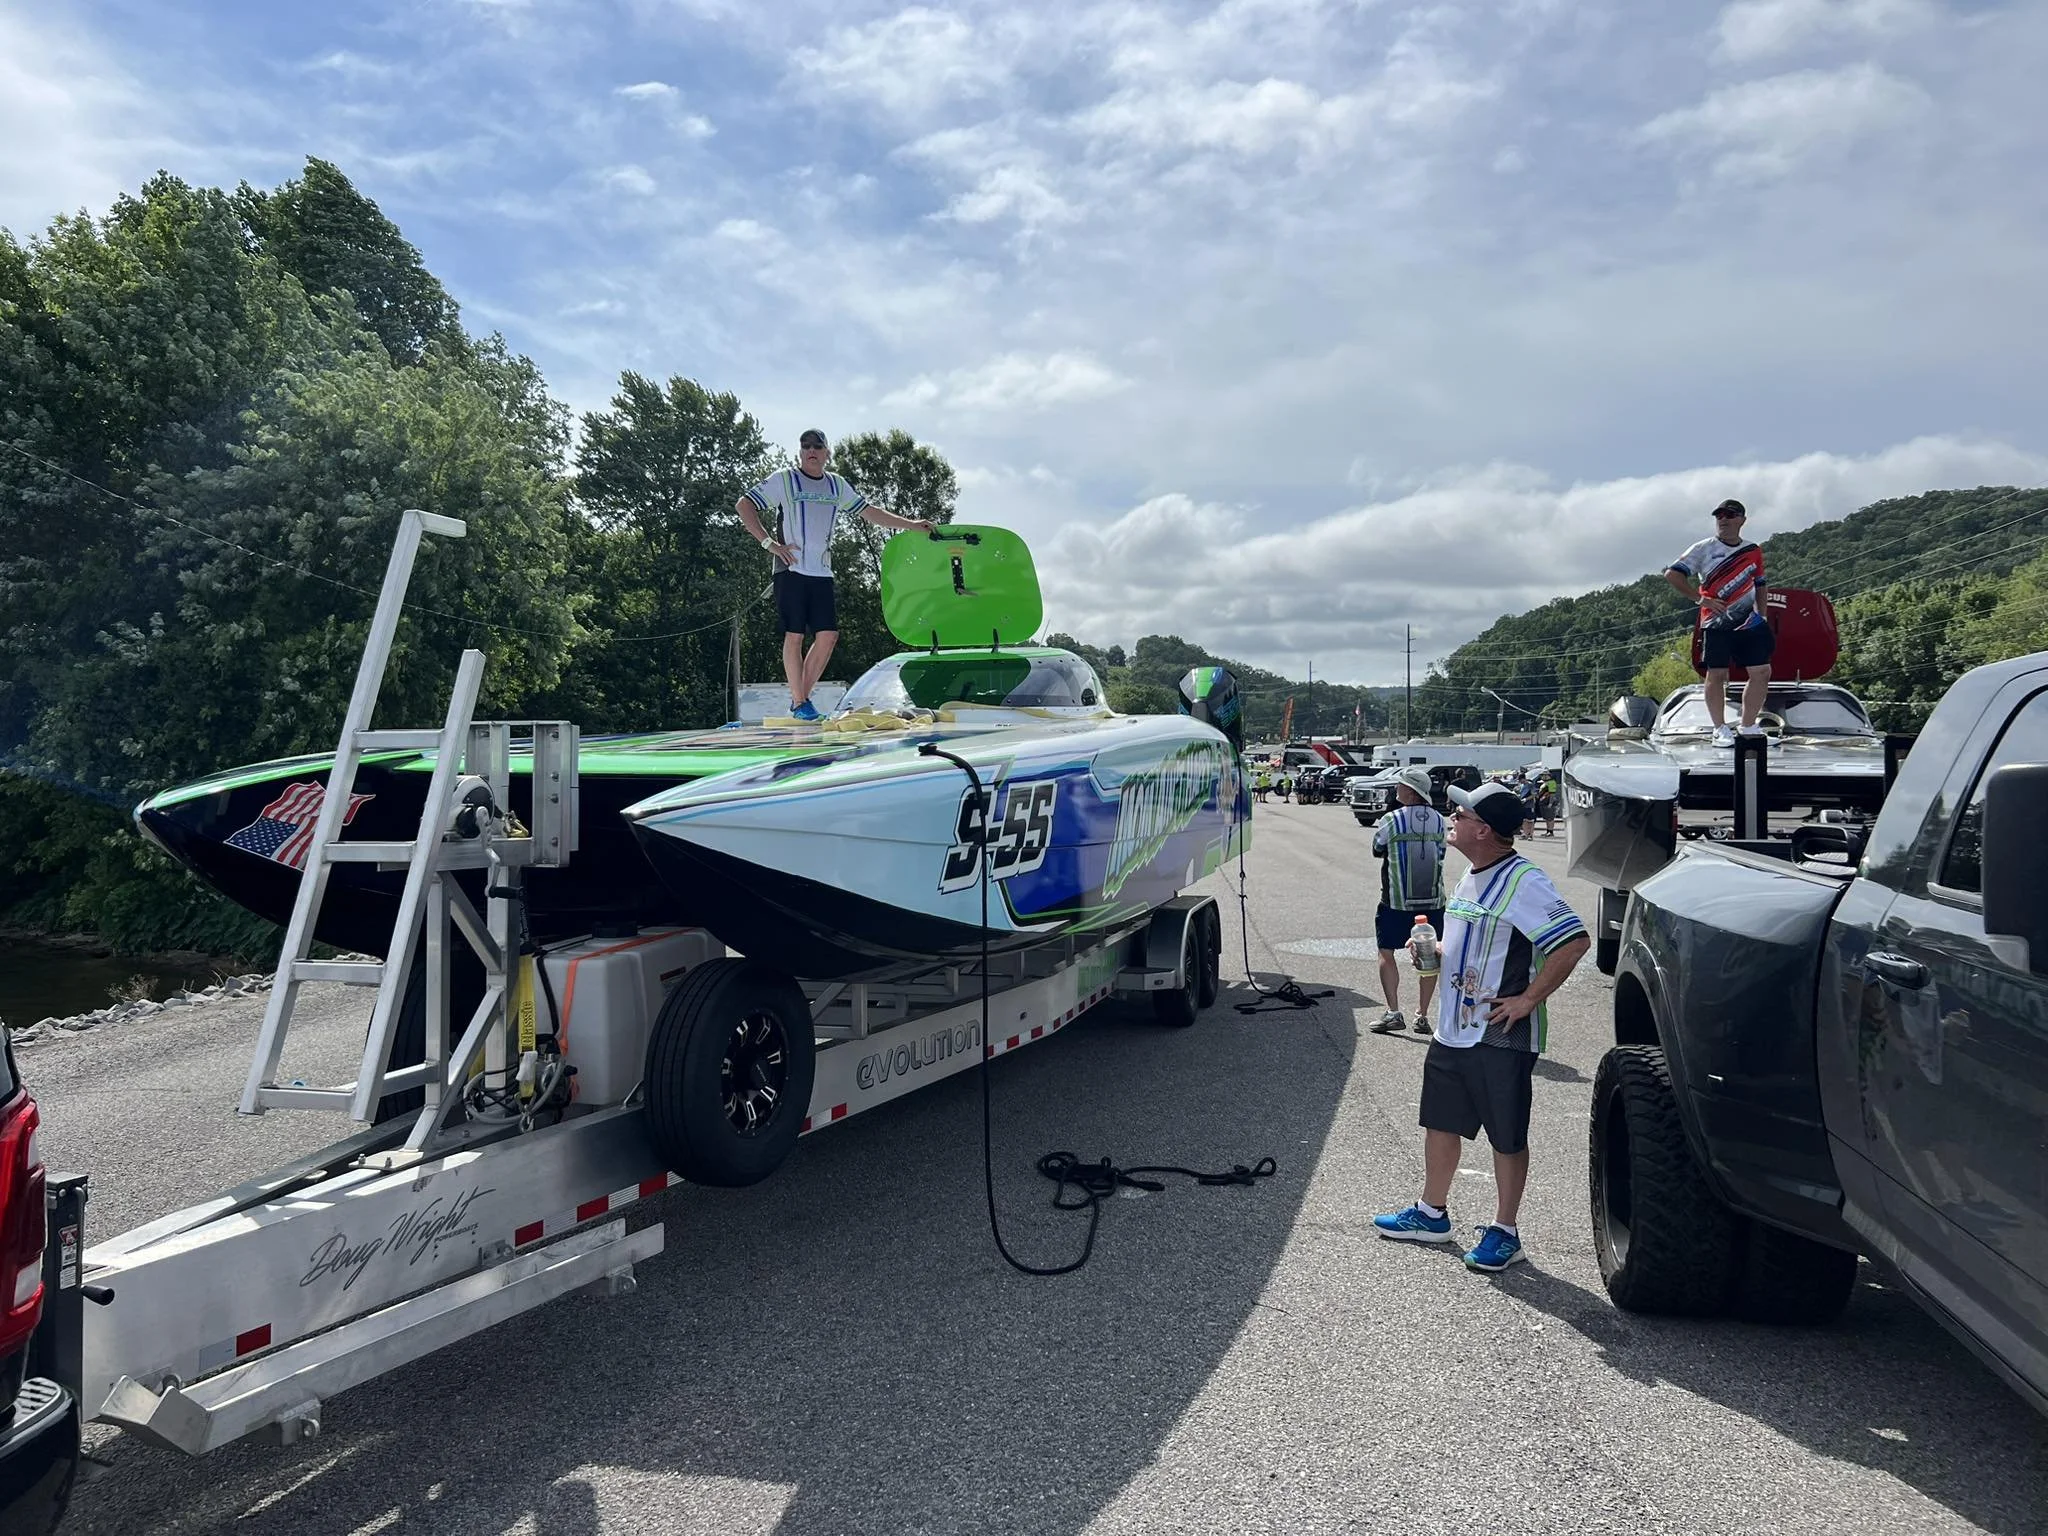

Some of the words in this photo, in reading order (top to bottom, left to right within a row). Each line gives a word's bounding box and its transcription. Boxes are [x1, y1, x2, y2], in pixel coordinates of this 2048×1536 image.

[1767, 592, 1787, 603] CUE
[300, 1232, 386, 1291] Doug
[382, 1185, 497, 1266] Wright
